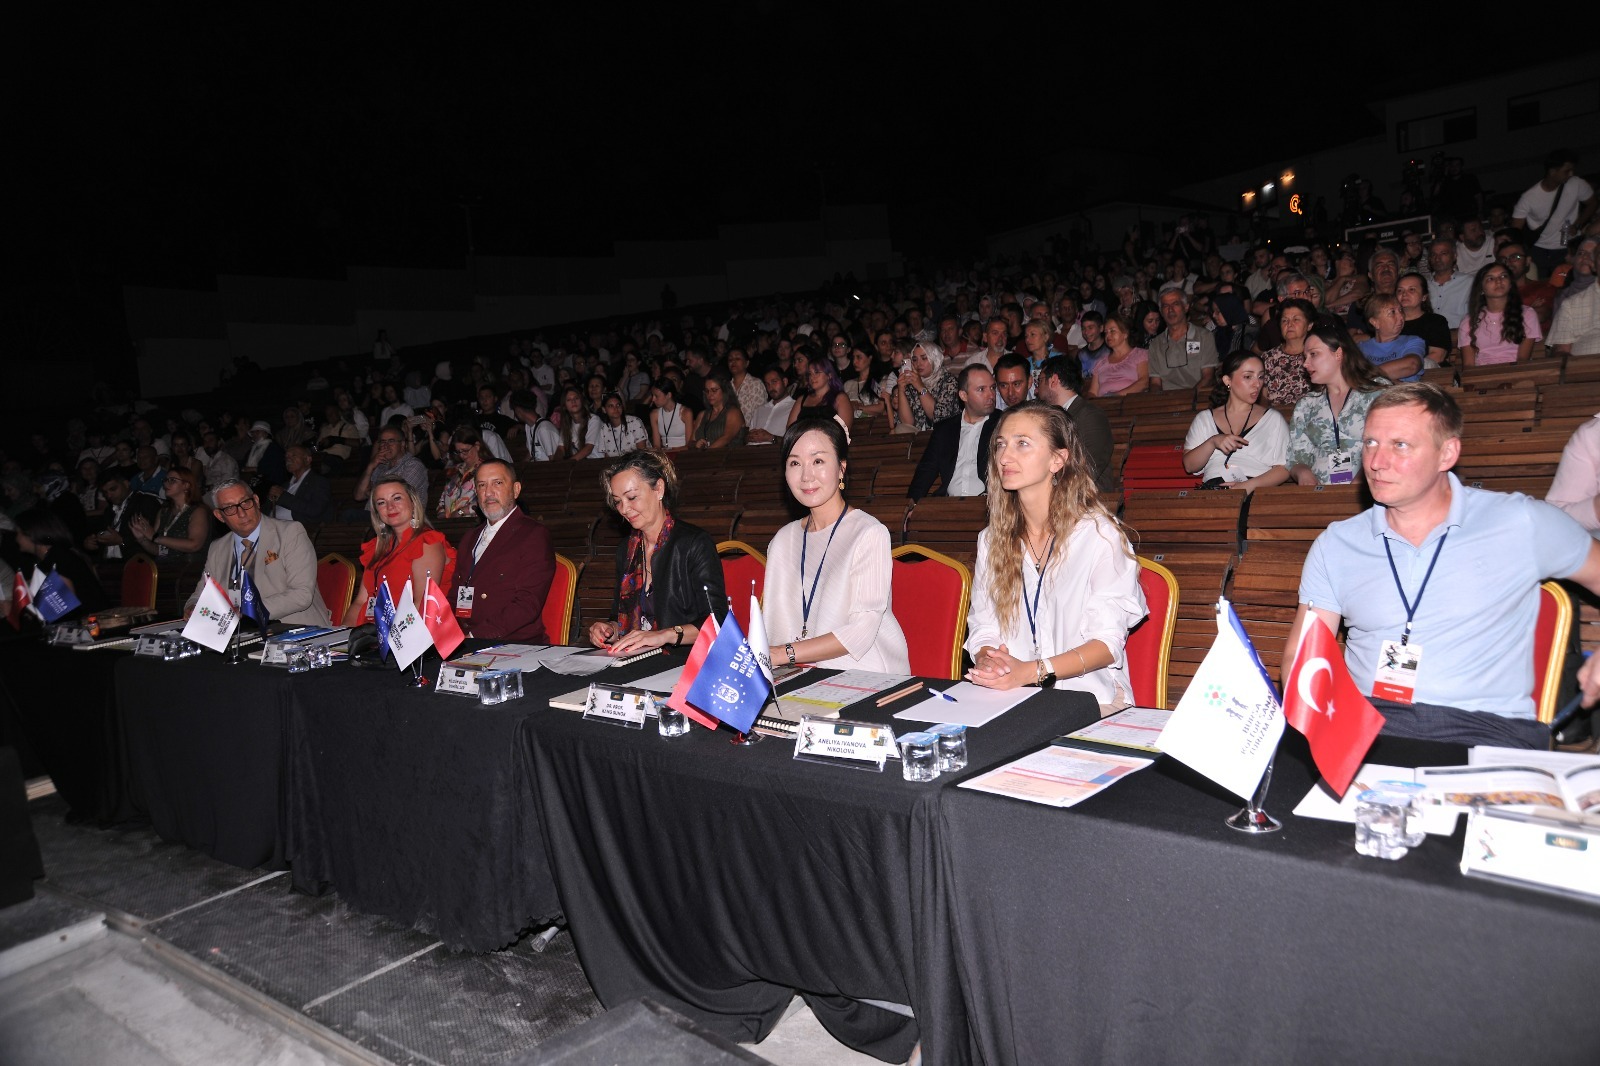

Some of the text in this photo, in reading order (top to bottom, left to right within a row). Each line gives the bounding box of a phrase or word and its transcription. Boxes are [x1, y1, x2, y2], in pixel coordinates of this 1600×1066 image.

[730, 638, 750, 670] BURS
[739, 650, 754, 674] BÜYÜK
[818, 738, 840, 746] ANELIYA
[827, 746, 855, 754] NIKOLOVA
